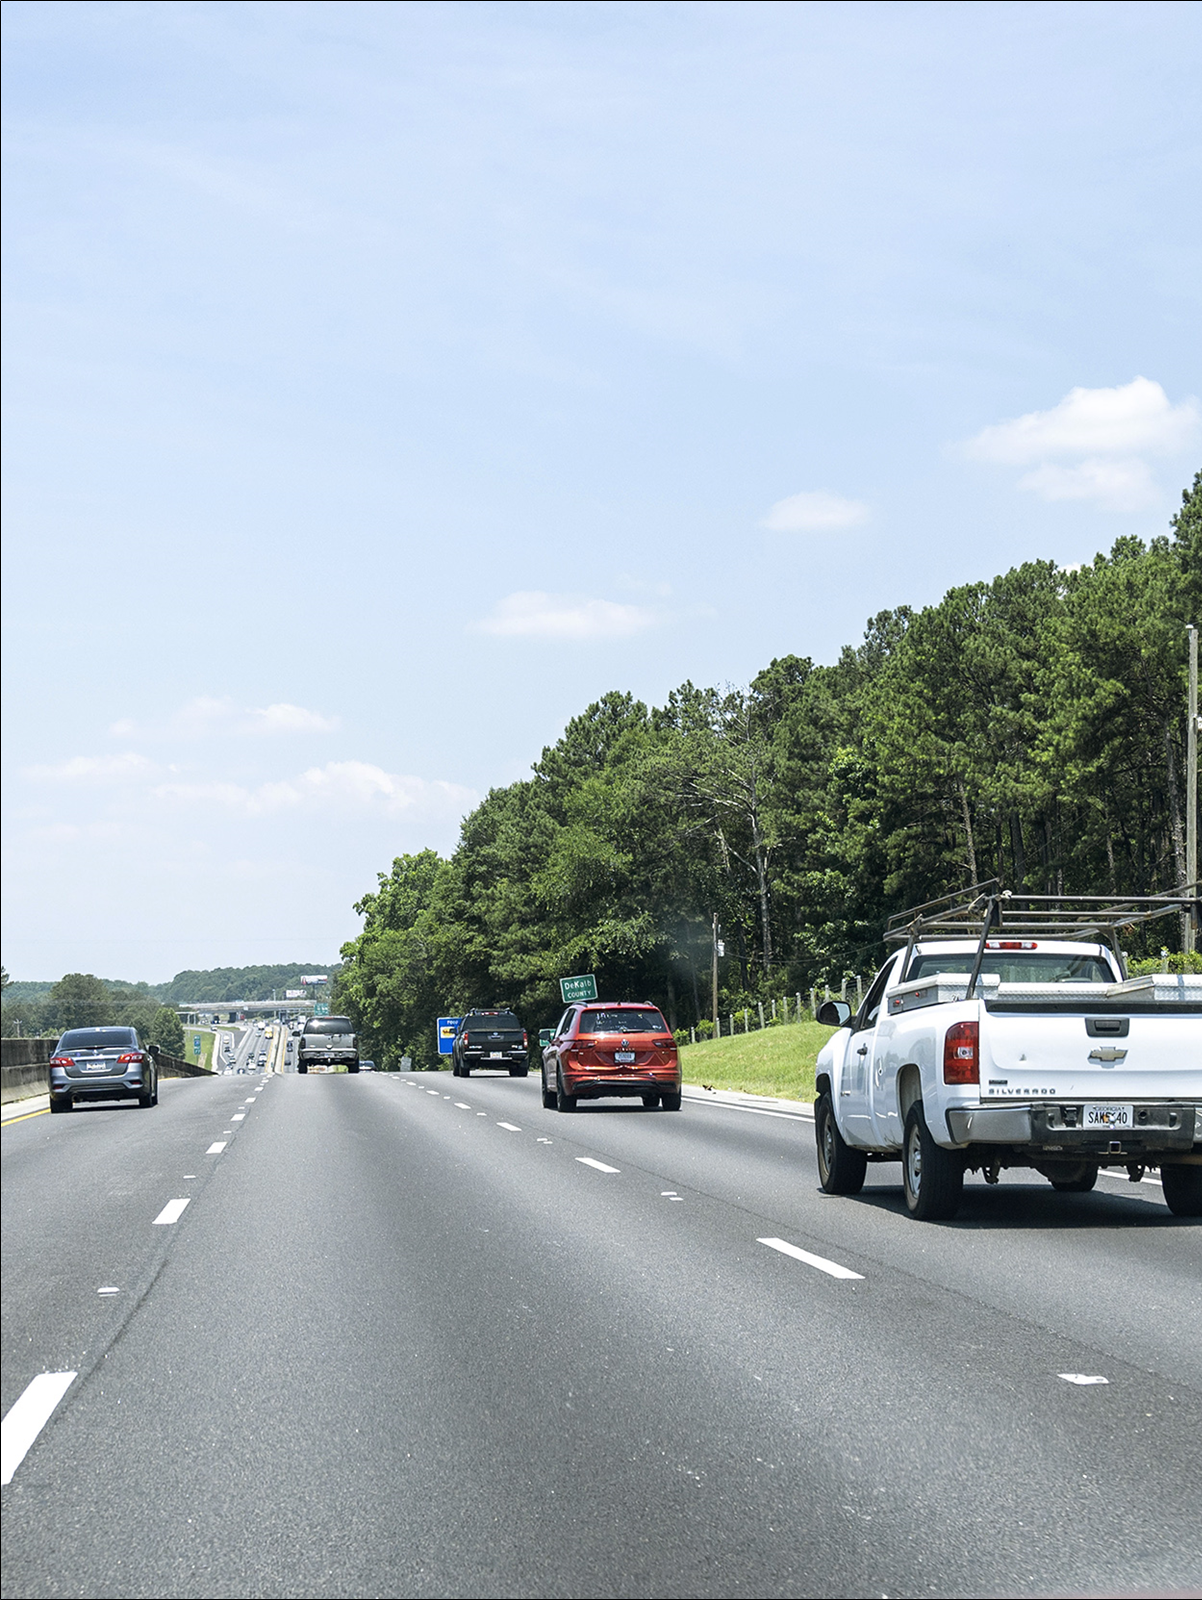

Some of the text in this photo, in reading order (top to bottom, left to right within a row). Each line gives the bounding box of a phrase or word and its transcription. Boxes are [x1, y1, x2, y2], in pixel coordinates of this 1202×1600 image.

[564, 980, 592, 990] DeKalb
[567, 990, 592, 999] COUNTY
[1088, 1111, 1128, 1124] SAK540
